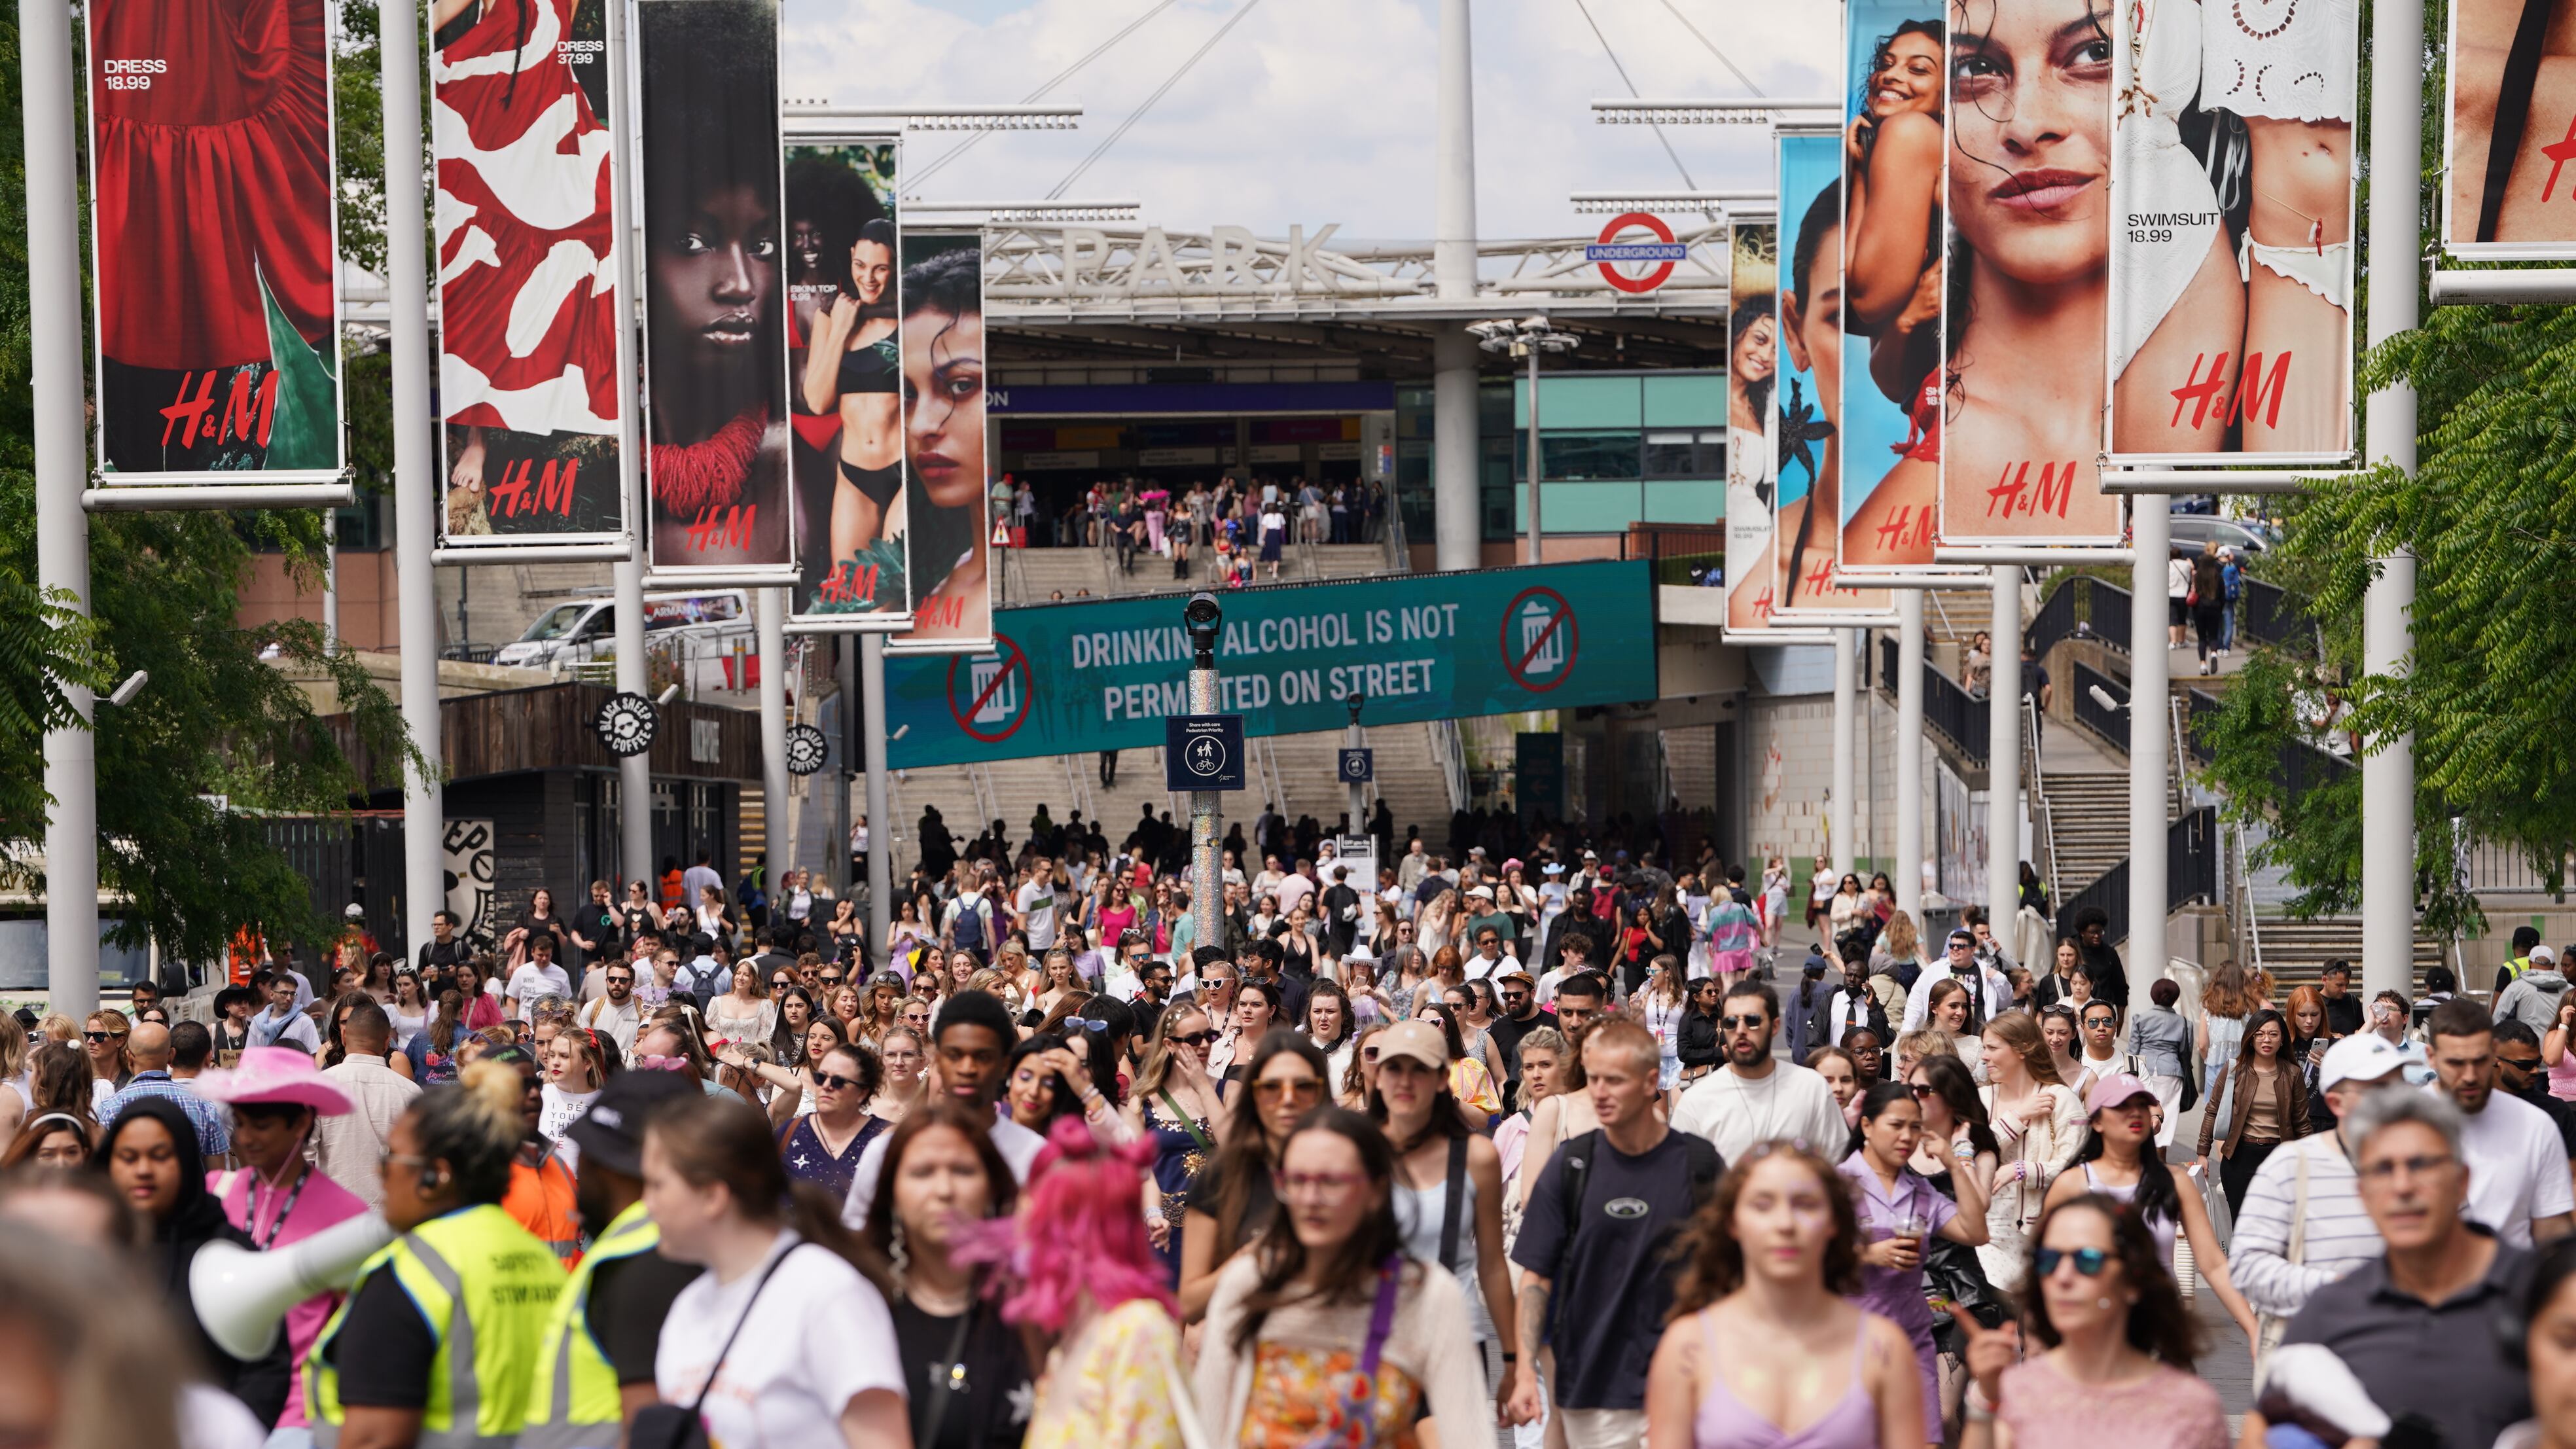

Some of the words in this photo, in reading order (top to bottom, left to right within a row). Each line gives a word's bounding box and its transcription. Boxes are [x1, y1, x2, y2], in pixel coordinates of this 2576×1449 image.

[557, 41, 604, 52] DRESS
[557, 53, 594, 63] 37.99
[104, 60, 167, 73] DRESS
[105, 75, 151, 90] 18.99
[2128, 213, 2219, 226] SWIMSUIT
[2128, 229, 2172, 243] 18.99
[1062, 223, 1344, 293] PARK
[1588, 247, 1684, 260] UNDERGROUND
[790, 285, 817, 294] BIKINI
[817, 284, 838, 293] TOP
[2170, 351, 2292, 430] H&M
[159, 370, 279, 449] H&M
[490, 457, 579, 518] H&M
[1987, 461, 2077, 519] H&M
[686, 504, 757, 551] H&M
[820, 564, 879, 603] H&M
[914, 596, 965, 629] H&M
[1072, 626, 1193, 669] DRINKIN
[1222, 612, 1358, 656] ALCOHOL
[1365, 609, 1393, 643] IS
[1401, 603, 1459, 641] NOT
[1104, 674, 1271, 721] PERMTED
[1279, 669, 1321, 706] ON
[1329, 658, 1435, 701] STREET
[599, 699, 622, 732] BLACK
[622, 696, 653, 720] SHEEP
[611, 729, 652, 753] COFFEE
[800, 727, 824, 747] SHEEP
[789, 754, 823, 772] COFFEE
[551, 1112, 575, 1121] YOU
